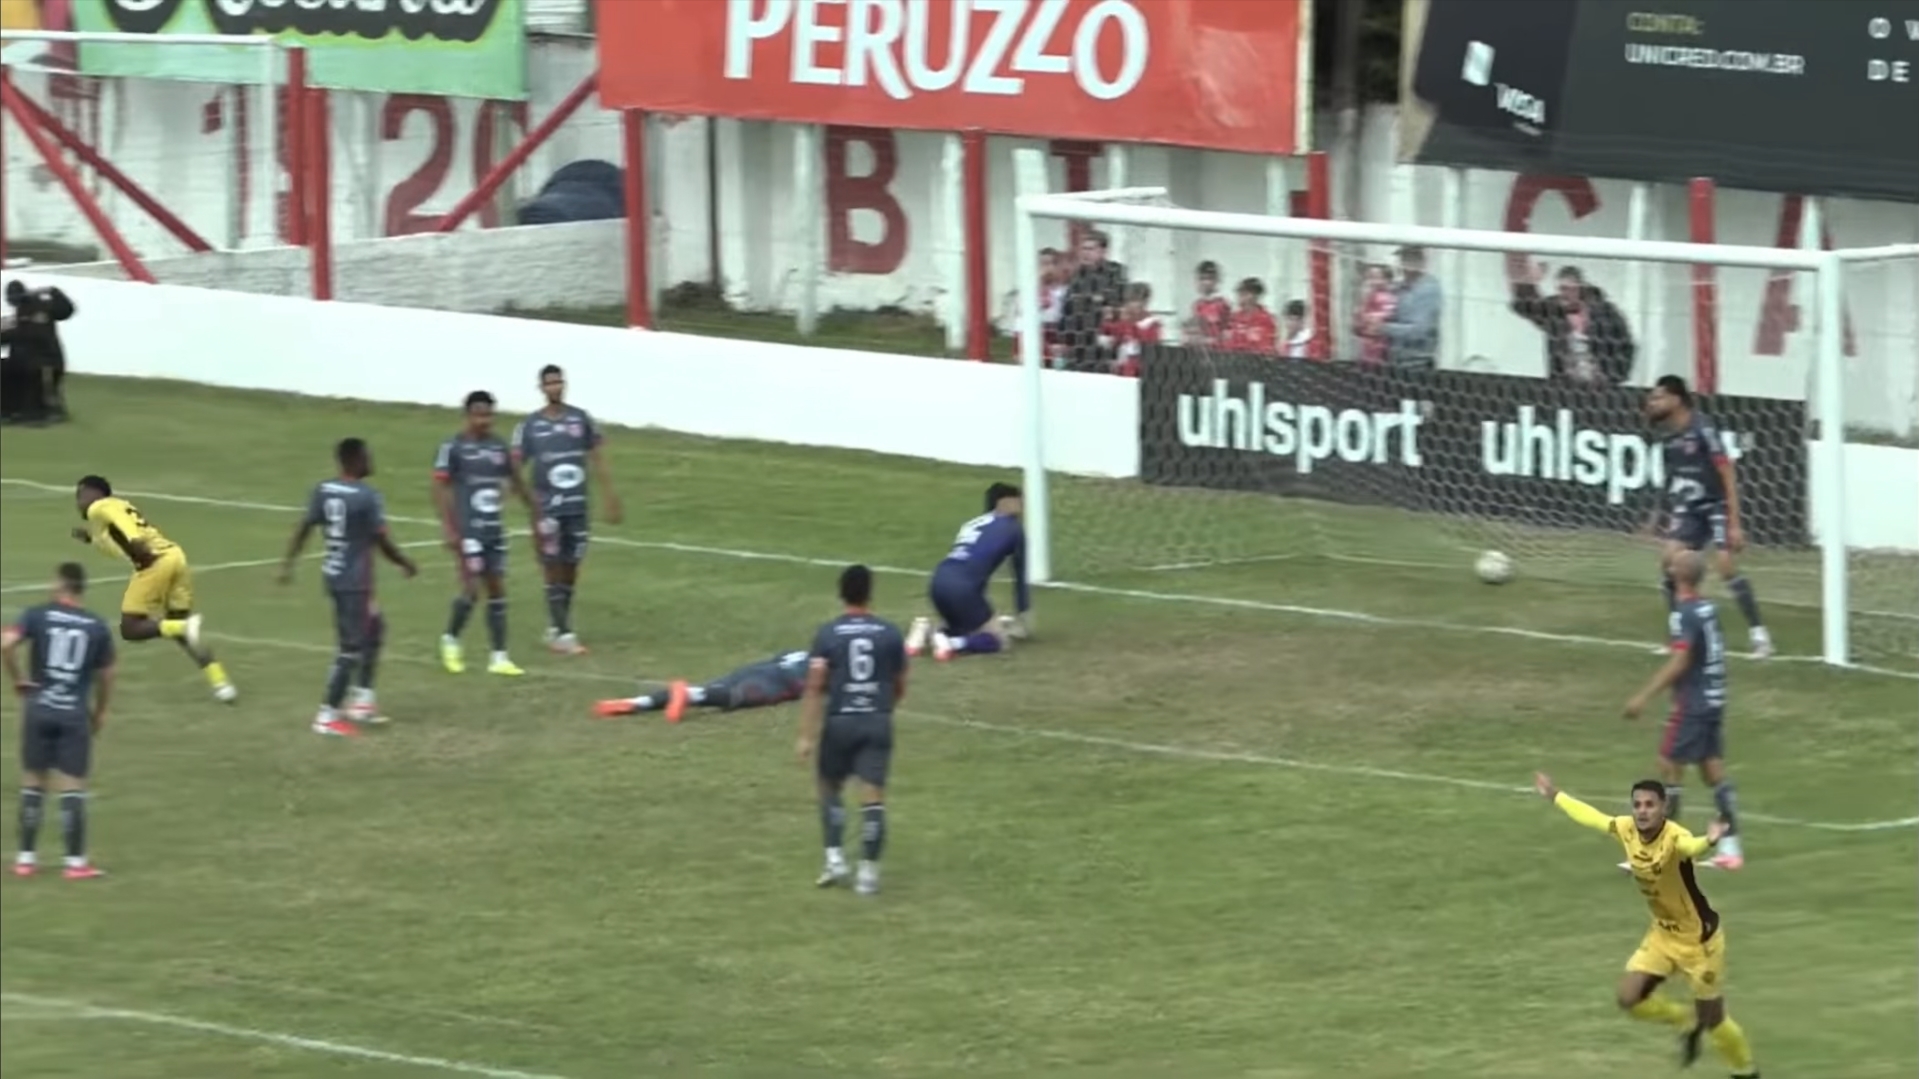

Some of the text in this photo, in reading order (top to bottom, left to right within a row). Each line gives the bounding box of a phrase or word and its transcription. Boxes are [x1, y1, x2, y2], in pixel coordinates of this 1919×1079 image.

[1868, 17, 1892, 39] O
[724, 0, 1149, 100] PERUZZO
[1867, 59, 1911, 83] DE
[1178, 379, 1742, 505] uhlsport uhlsp
[46, 627, 89, 670] 10
[848, 638, 875, 681] 6
